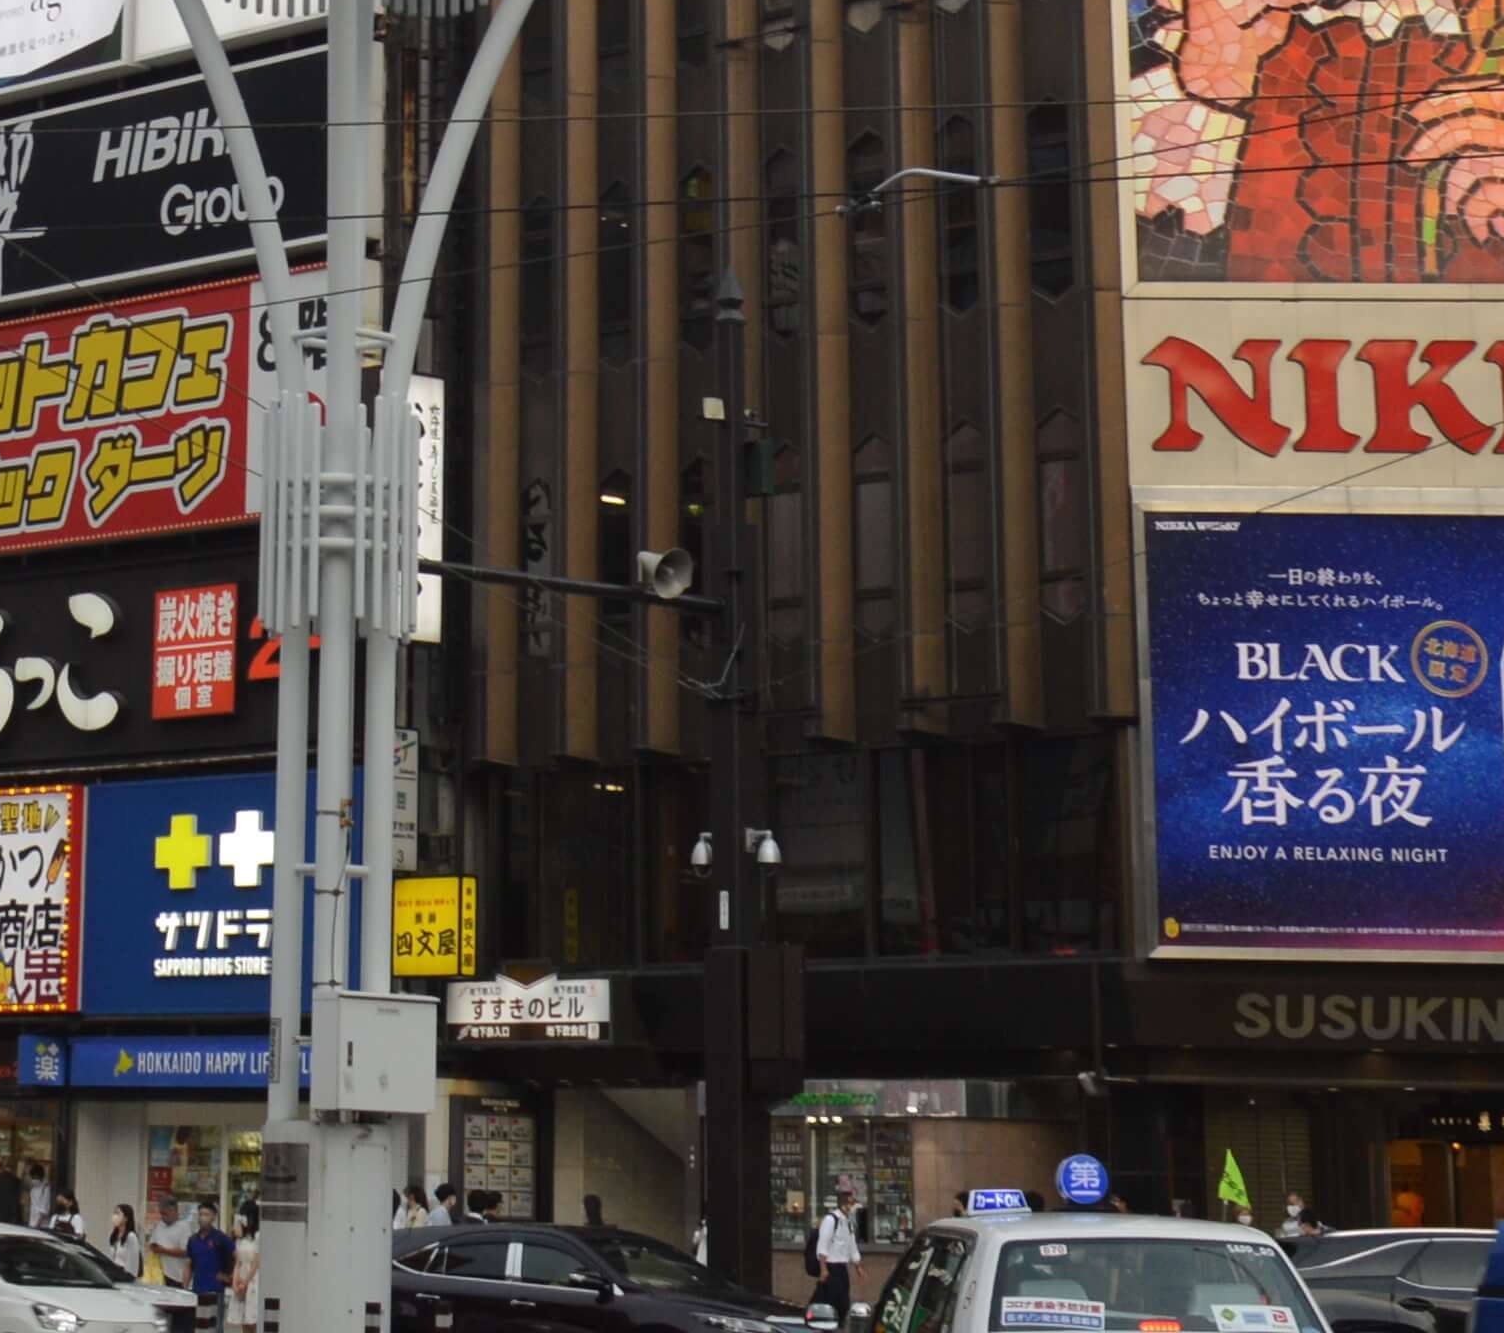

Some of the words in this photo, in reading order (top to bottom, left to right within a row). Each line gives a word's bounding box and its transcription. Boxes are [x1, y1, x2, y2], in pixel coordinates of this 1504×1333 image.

[83, 419, 227, 524] ダーツ
[1268, 568, 1383, 587] 一日の終わりを、
[1197, 590, 1443, 611] ちょっと幸せにしてくれるハイボール。
[157, 594, 235, 643] 炭火焼き
[1235, 642, 1406, 683] BLACK
[1424, 637, 1477, 664] 北海道
[156, 648, 233, 688] 掘り炬燵
[1428, 661, 1468, 683] 限定
[173, 685, 212, 712] 個室
[1179, 697, 1467, 753] ハイボール
[1221, 754, 1433, 828] 香る夜
[1209, 844, 1268, 861] ENJOY
[1274, 845, 1288, 860] A
[1293, 845, 1384, 861] RELAXING
[1391, 847, 1448, 862] NIGHT
[396, 928, 456, 957] 四文屋
[153, 957, 201, 978] SAPPORO
[203, 957, 232, 977] DRUG
[234, 955, 271, 976] STORE
[471, 997, 585, 1020] すすきのビル
[35, 1056, 59, 1081] 薬
[137, 1051, 201, 1074] HOKKAIDO
[205, 1051, 247, 1074] HAPPY
[975, 1191, 1022, 1209] カードOK
